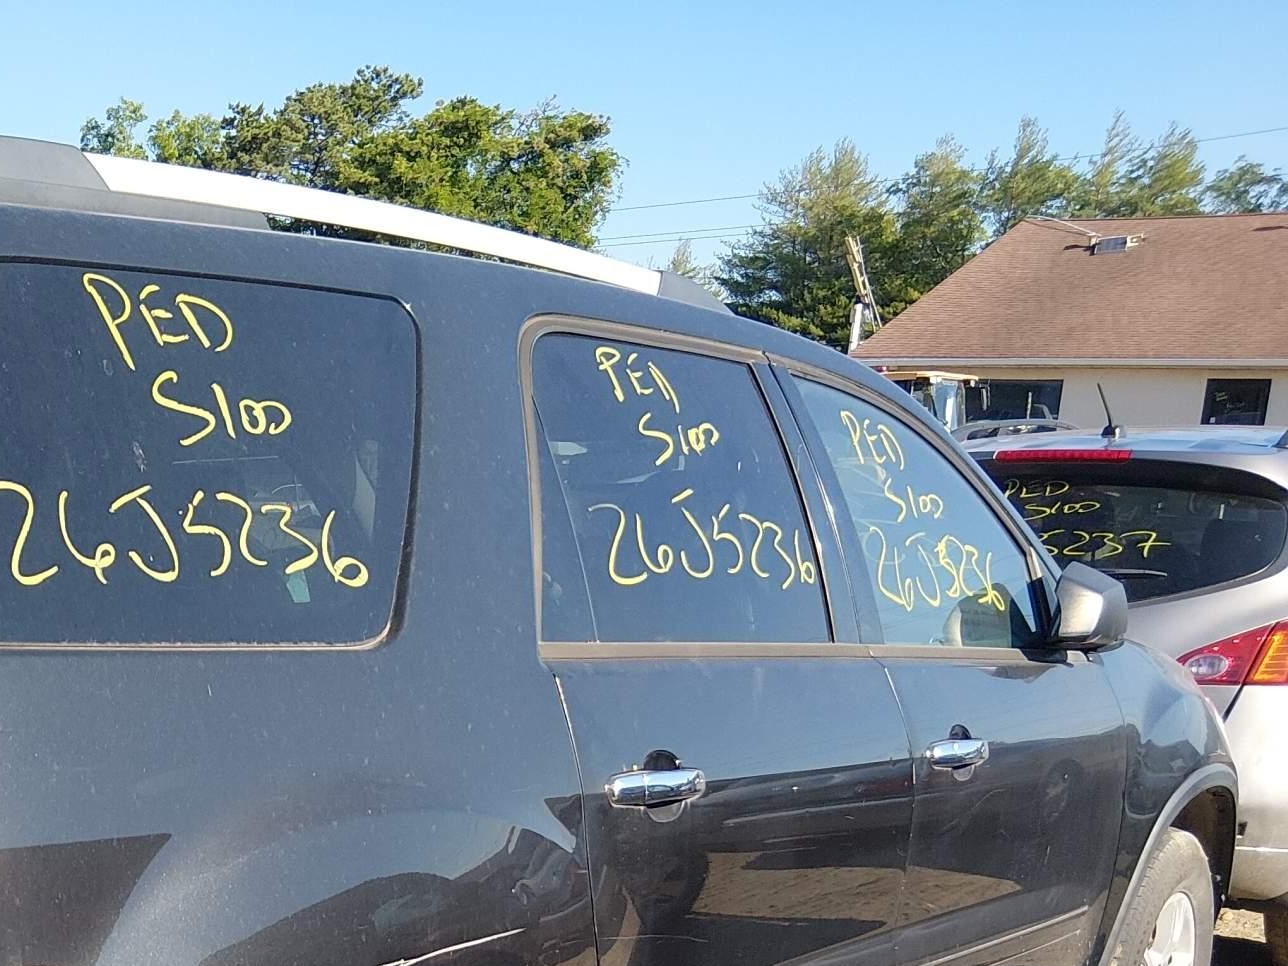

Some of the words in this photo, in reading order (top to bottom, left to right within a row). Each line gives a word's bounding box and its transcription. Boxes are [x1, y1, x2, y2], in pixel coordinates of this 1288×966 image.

[82, 271, 234, 371] PED
[150, 370, 292, 447] S100
[839, 410, 905, 471] PED
[883, 477, 944, 523] S100
[1023, 501, 1101, 521] S100
[586, 488, 816, 591] 26J5236
